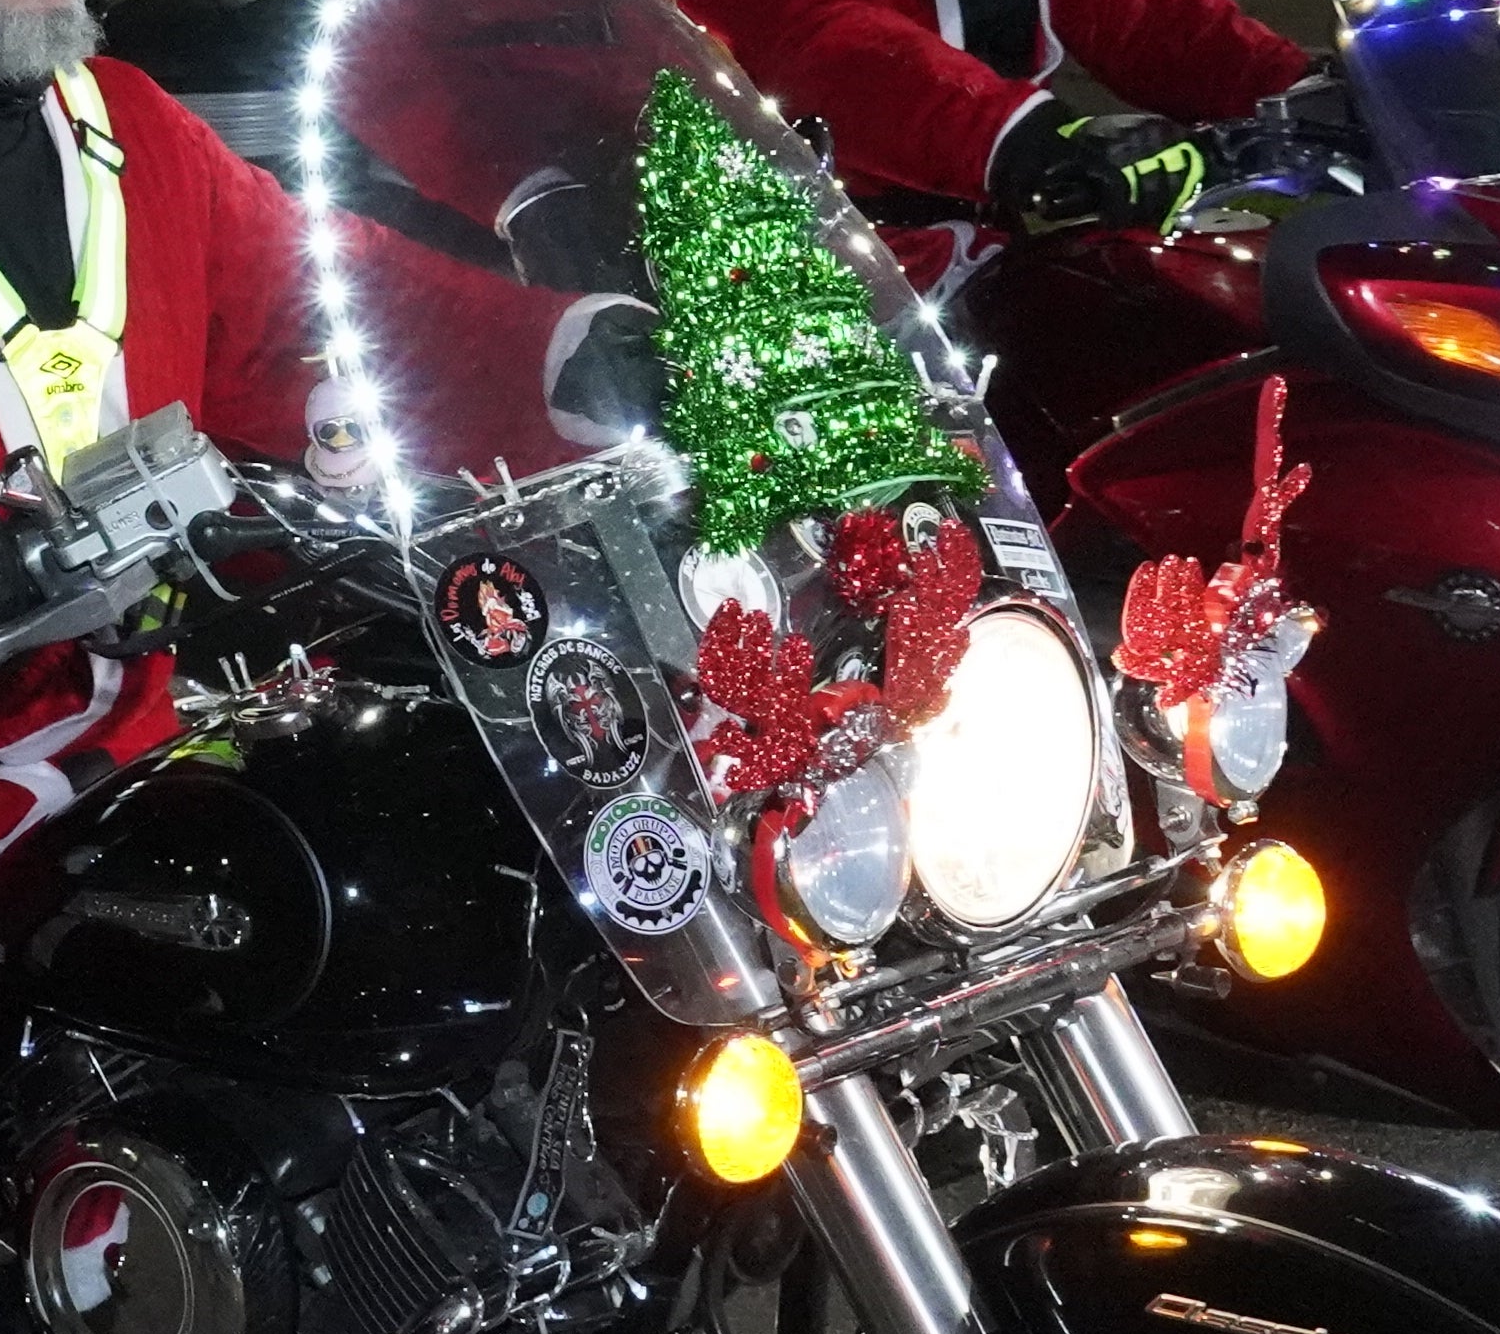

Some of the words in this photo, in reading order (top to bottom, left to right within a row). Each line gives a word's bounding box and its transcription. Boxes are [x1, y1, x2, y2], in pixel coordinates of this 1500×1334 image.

[46, 381, 85, 395] umbro
[582, 751, 641, 784] BADAJOZ
[611, 827, 629, 870] MOTO
[632, 818, 677, 846] GRUPO
[634, 875, 681, 901] PACENSE
